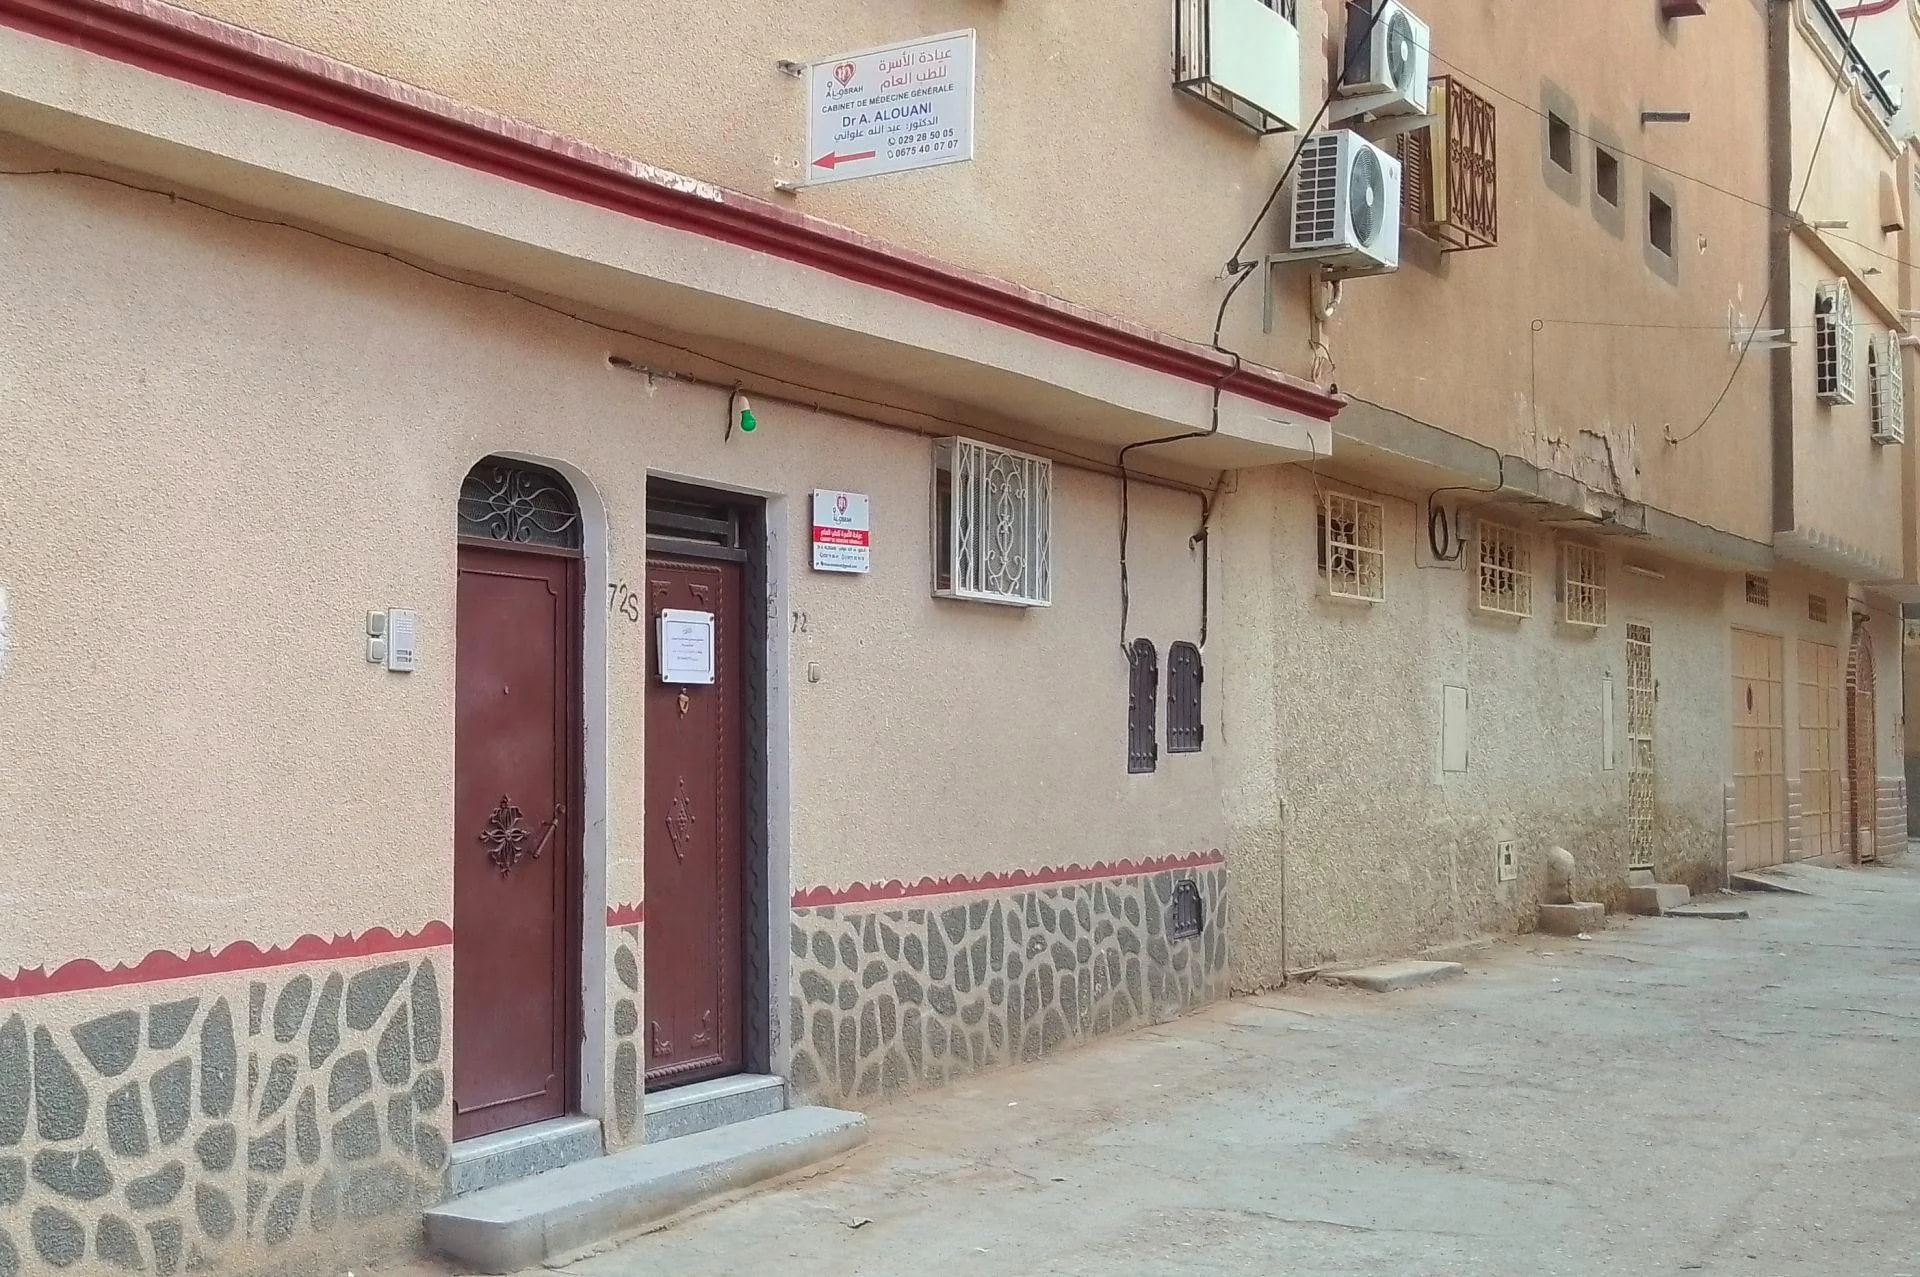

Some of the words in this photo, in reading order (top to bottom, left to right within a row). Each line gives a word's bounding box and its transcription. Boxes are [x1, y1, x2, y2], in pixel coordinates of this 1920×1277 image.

[879, 51, 915, 73] الأسرة
[919, 49, 952, 63] عيادة
[880, 72, 911, 93] العام
[916, 65, 947, 84] للطب
[822, 102, 855, 113] CABINET
[869, 91, 909, 105] MÉDECINE
[911, 83, 954, 98] GÉNÉRALE
[826, 85, 864, 99] AL-OSRAH
[843, 117, 856, 127] Dr
[859, 114, 871, 125] A.
[874, 102, 932, 122] ALOUANI
[868, 125, 884, 135] الله
[887, 125, 901, 134] عبد
[898, 135, 914, 145] 029
[916, 132, 927, 142] 28
[930, 130, 941, 140] 50
[943, 128, 954, 138] 05
[895, 146, 917, 158] 0675
[919, 144, 930, 154] 40
[934, 141, 945, 151] 07
[947, 139, 958, 149] 07
